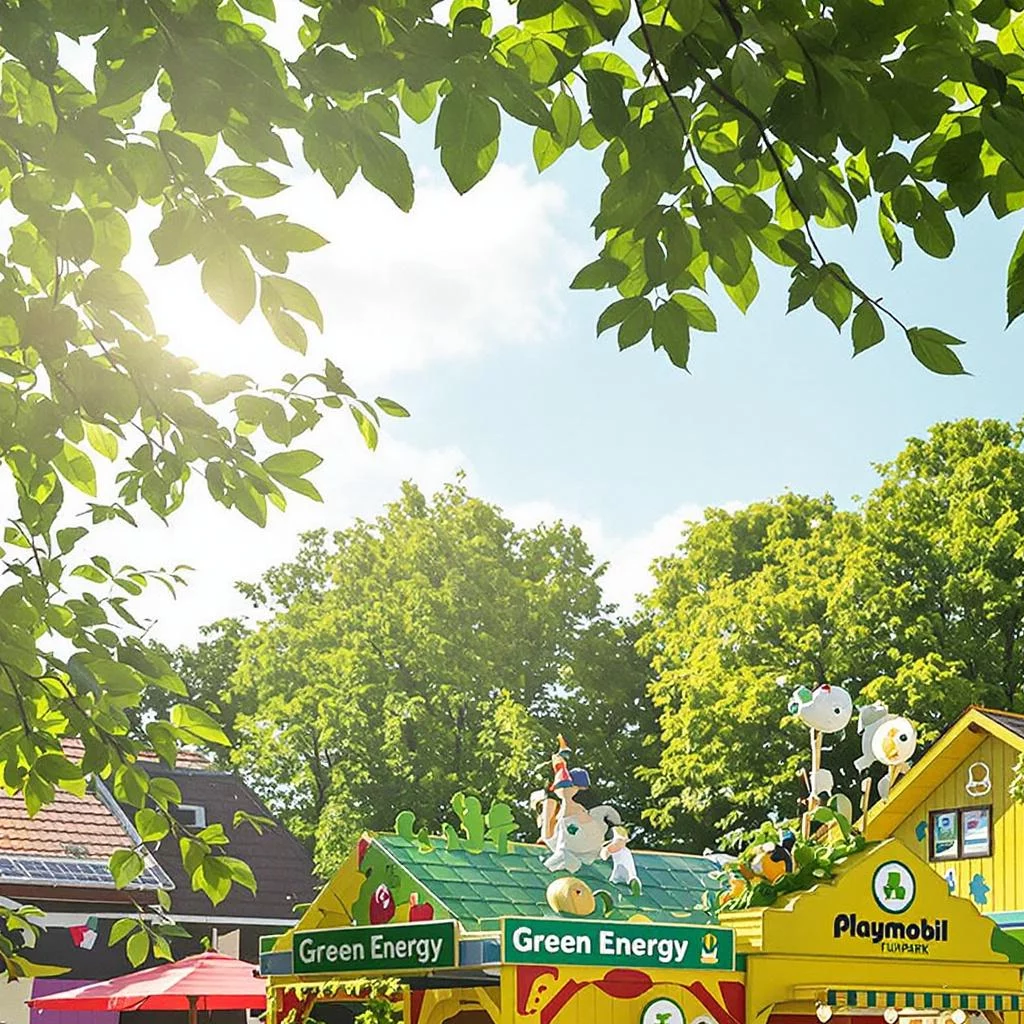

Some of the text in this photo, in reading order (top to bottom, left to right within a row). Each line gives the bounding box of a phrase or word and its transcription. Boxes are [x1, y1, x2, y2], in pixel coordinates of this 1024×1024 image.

[833, 913, 948, 944] Playmobil
[299, 934, 443, 964] Green Energy
[512, 926, 689, 963] Green Energy
